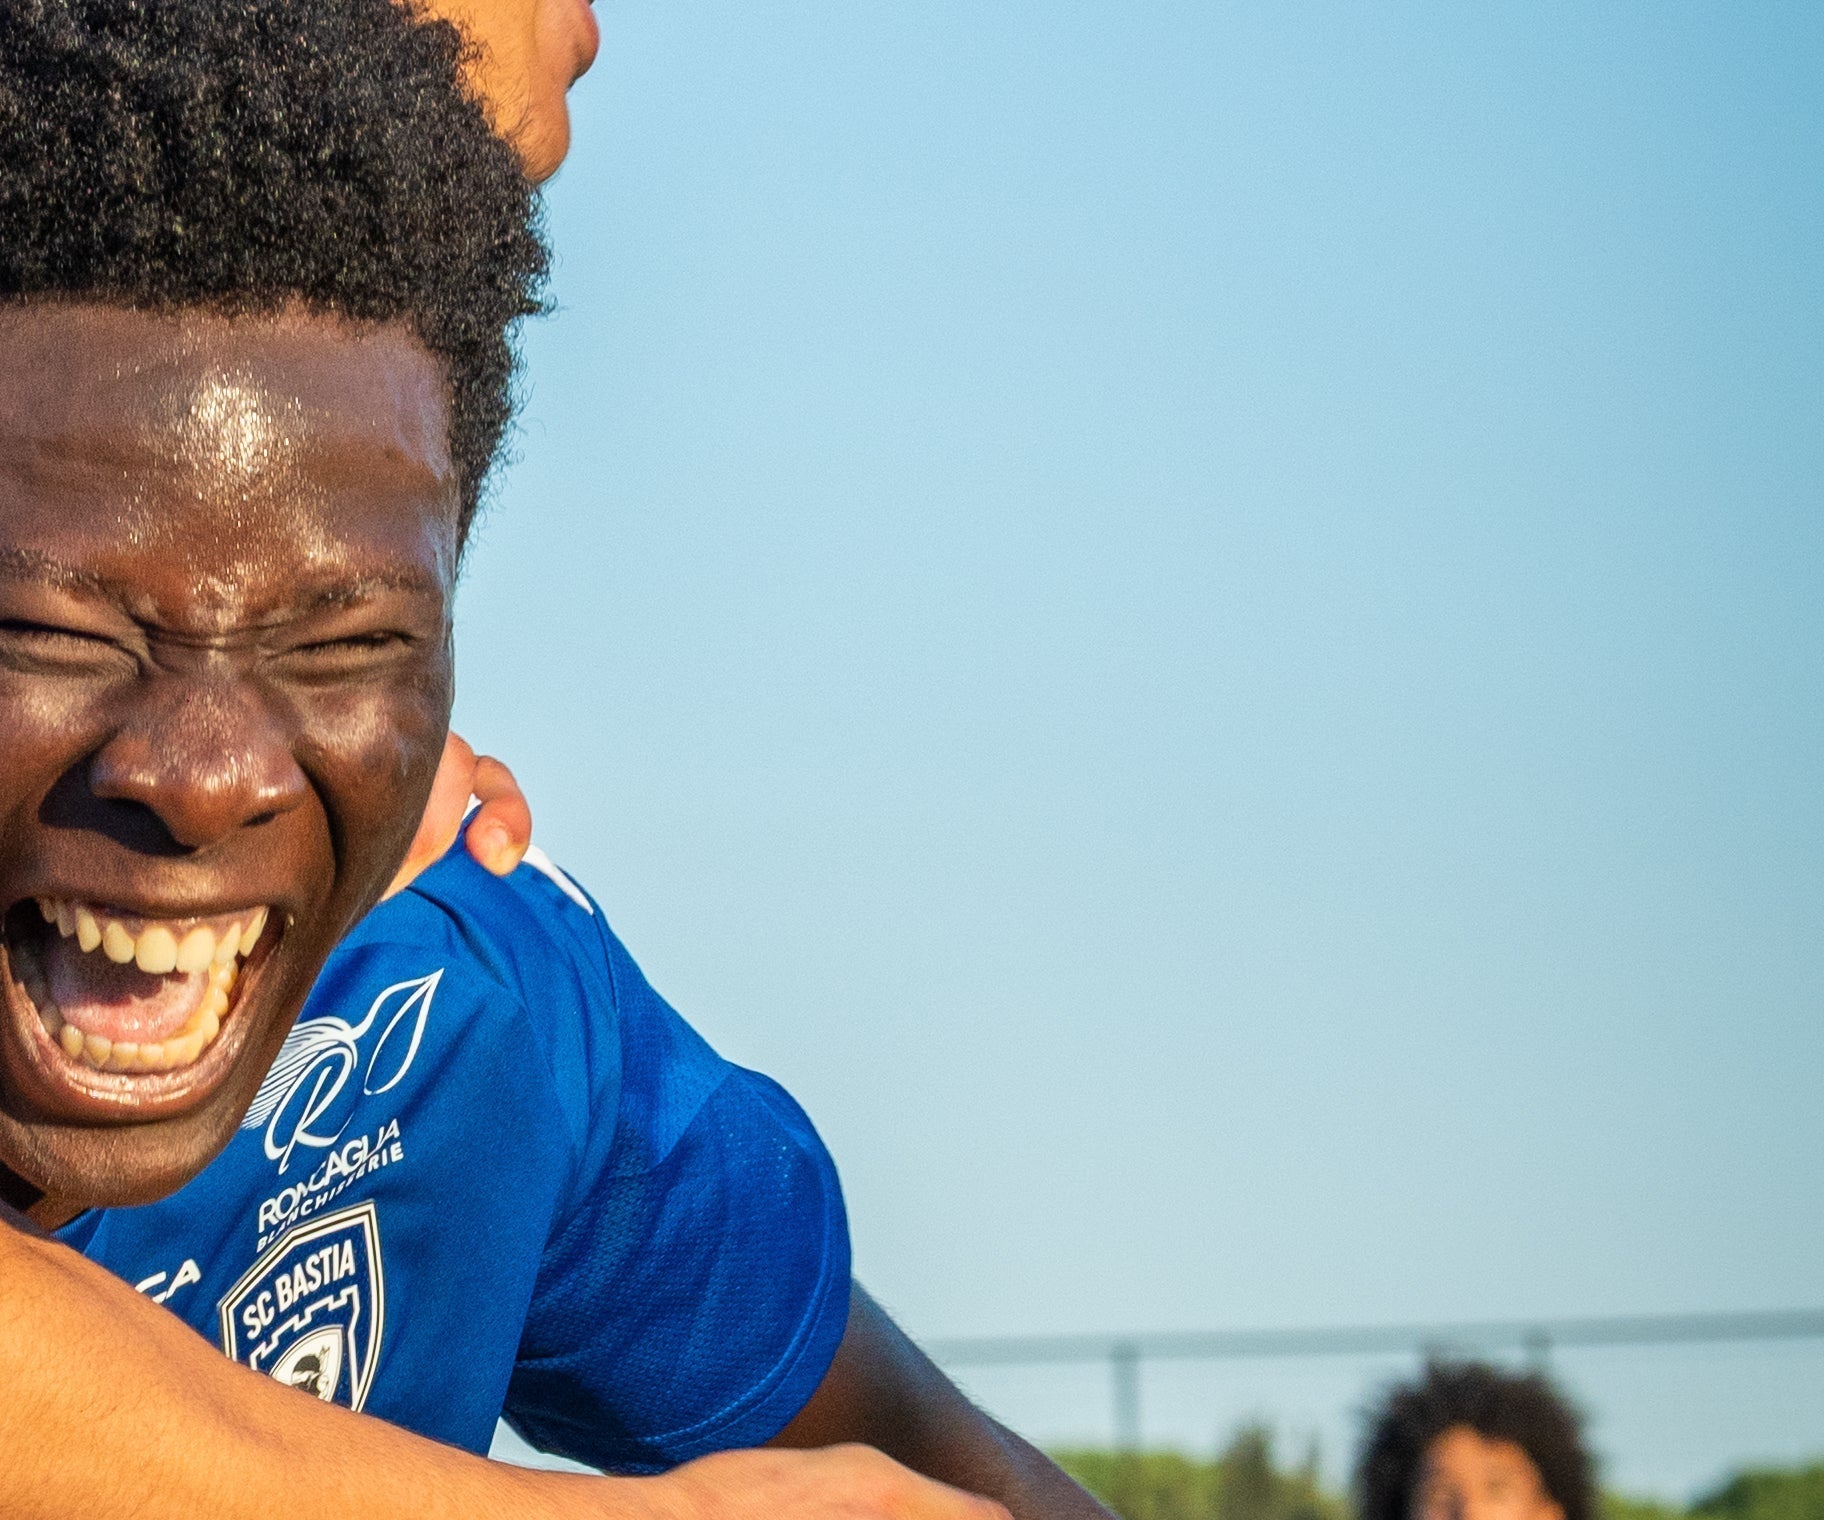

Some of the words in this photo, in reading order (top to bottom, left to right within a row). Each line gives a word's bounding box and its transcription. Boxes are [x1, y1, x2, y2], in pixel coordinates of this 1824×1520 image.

[257, 1141, 405, 1253] BLANCHISSERIE
[259, 1118, 400, 1233] RONCAGLIA
[243, 1291, 275, 1339] SC
[276, 1239, 356, 1315] BASTIA
